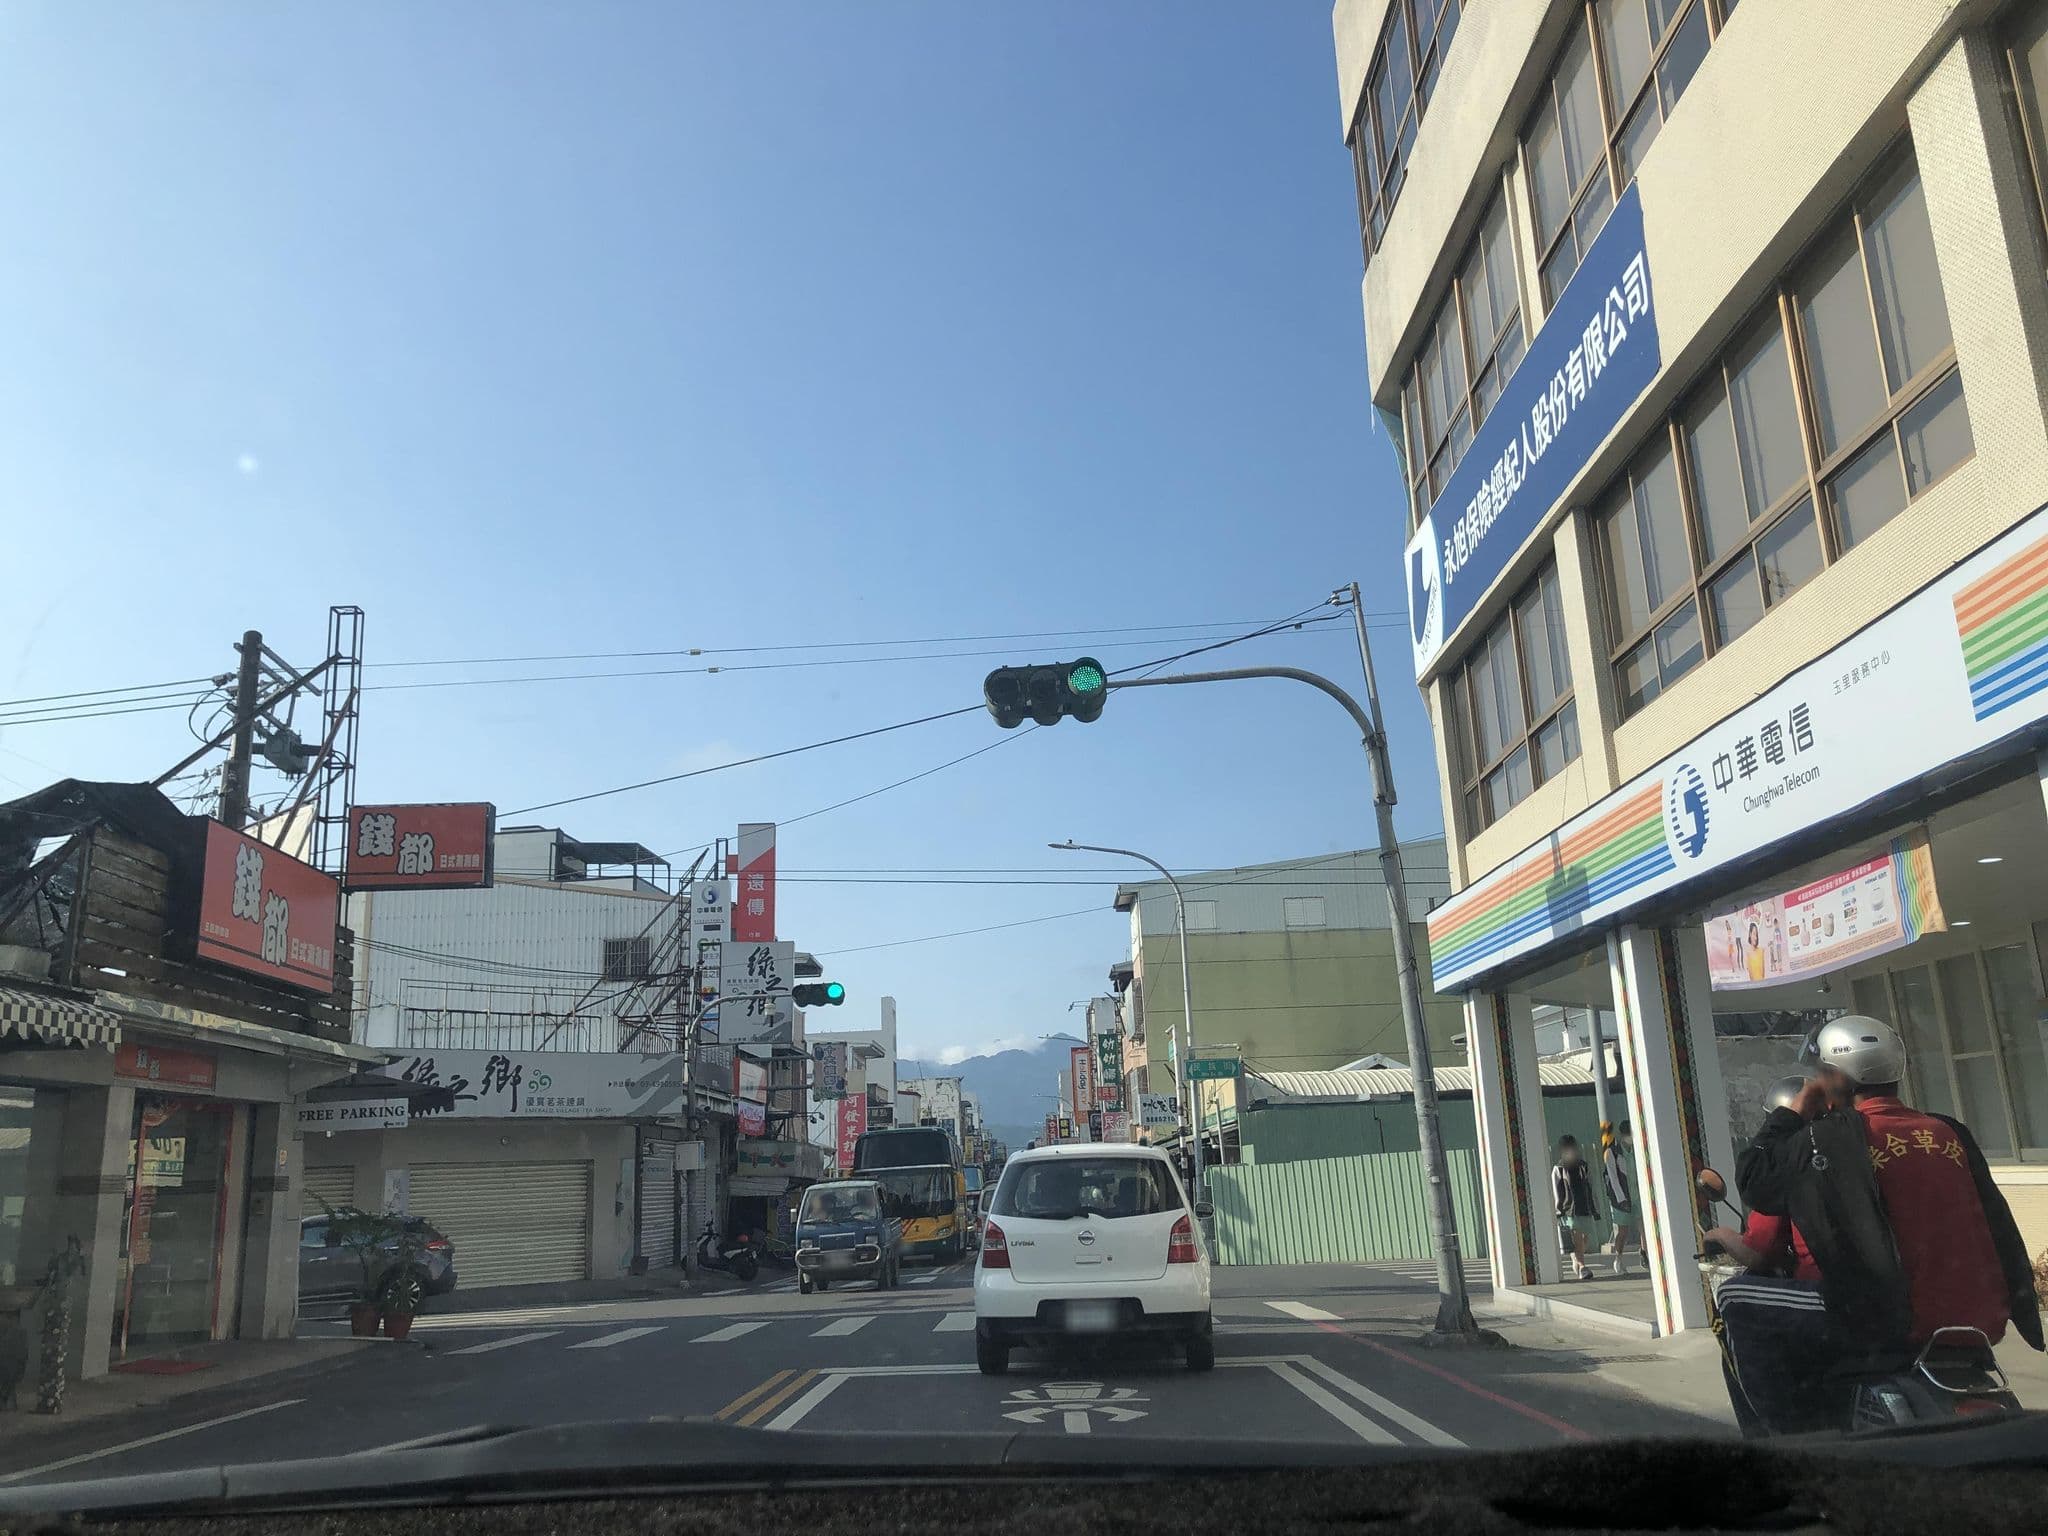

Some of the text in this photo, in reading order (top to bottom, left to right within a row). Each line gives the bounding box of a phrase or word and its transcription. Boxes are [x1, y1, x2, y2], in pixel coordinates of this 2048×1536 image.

[1443, 250, 1649, 585] 永旭保險經紀人股份有限公司
[1832, 650, 1891, 696] 玉里服務中心
[1711, 702, 1815, 794] 中華電信
[1743, 766, 1820, 813] Chunghwa Telecom
[357, 813, 434, 876] 錢都
[232, 842, 289, 967] 錢都
[746, 873, 766, 916] 遠傳
[1078, 1059, 1087, 1089] Holiday
[300, 1104, 406, 1122] FREE PARKING
[1104, 1114, 1127, 1130] 民宿
[1010, 1239, 1035, 1248] LIVINA
